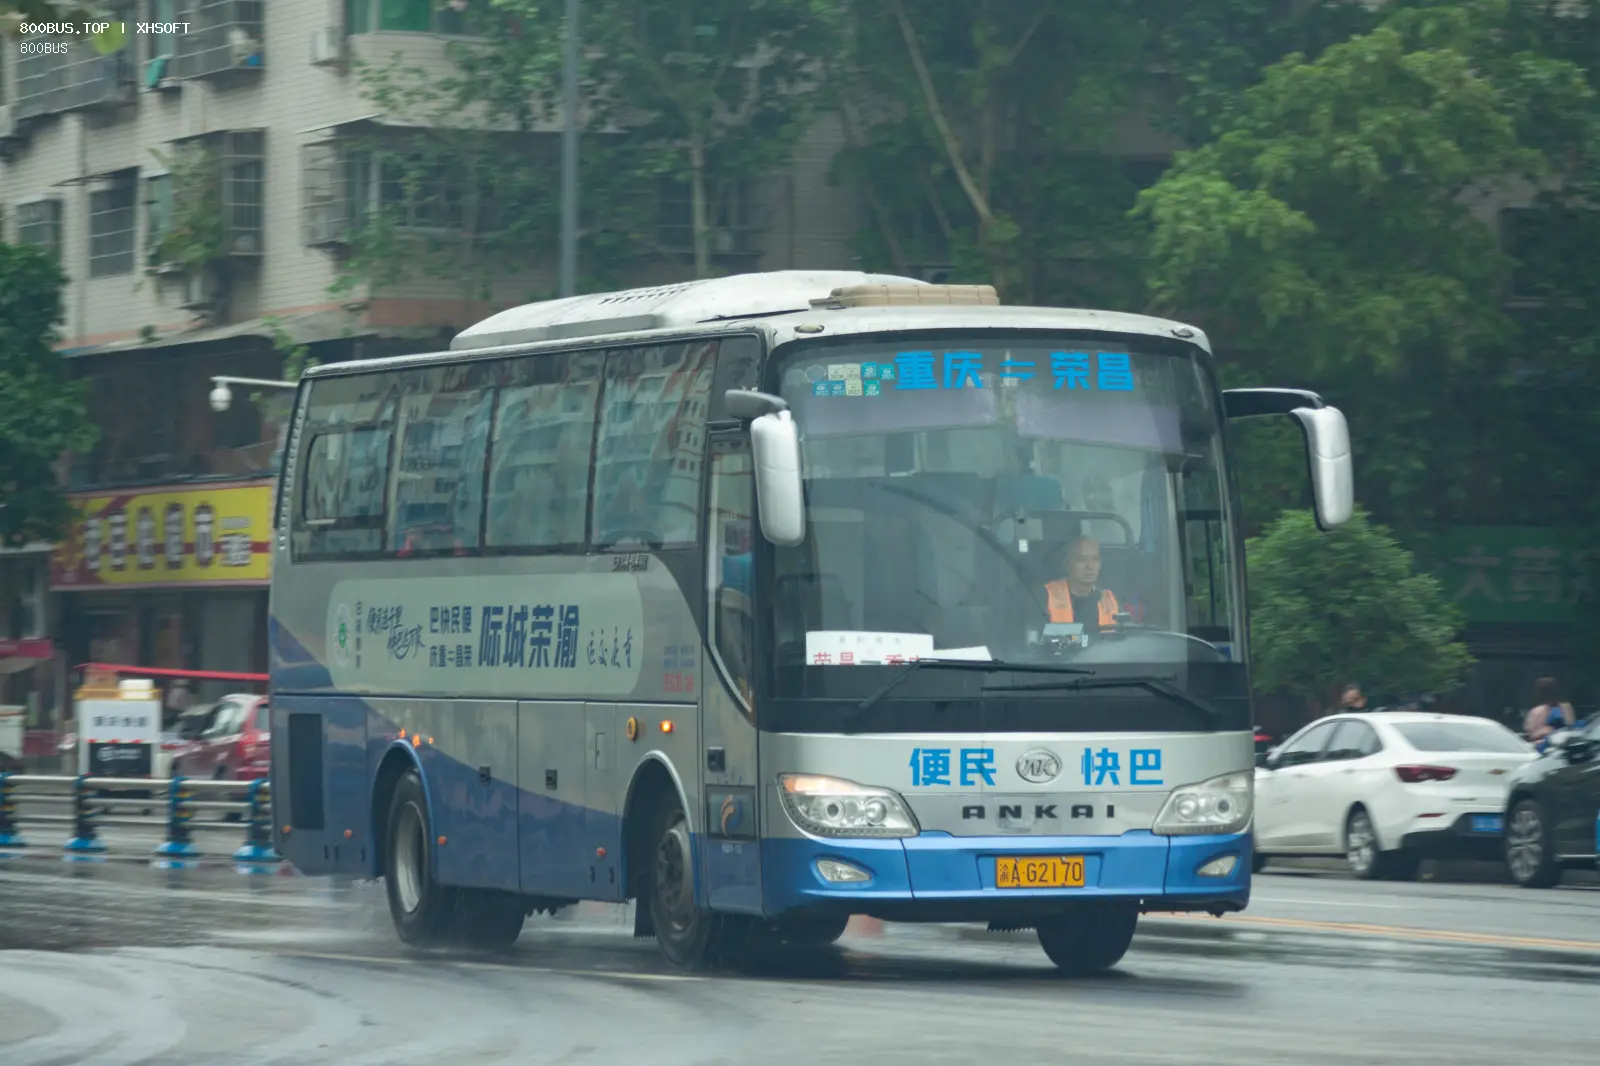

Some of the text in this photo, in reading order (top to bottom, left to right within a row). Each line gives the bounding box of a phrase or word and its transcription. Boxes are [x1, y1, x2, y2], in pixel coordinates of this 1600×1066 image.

[893, 351, 1134, 391] 重庆 荣昌
[909, 748, 1164, 787] 便民 快巴
[962, 804, 1115, 819] ANKAI
